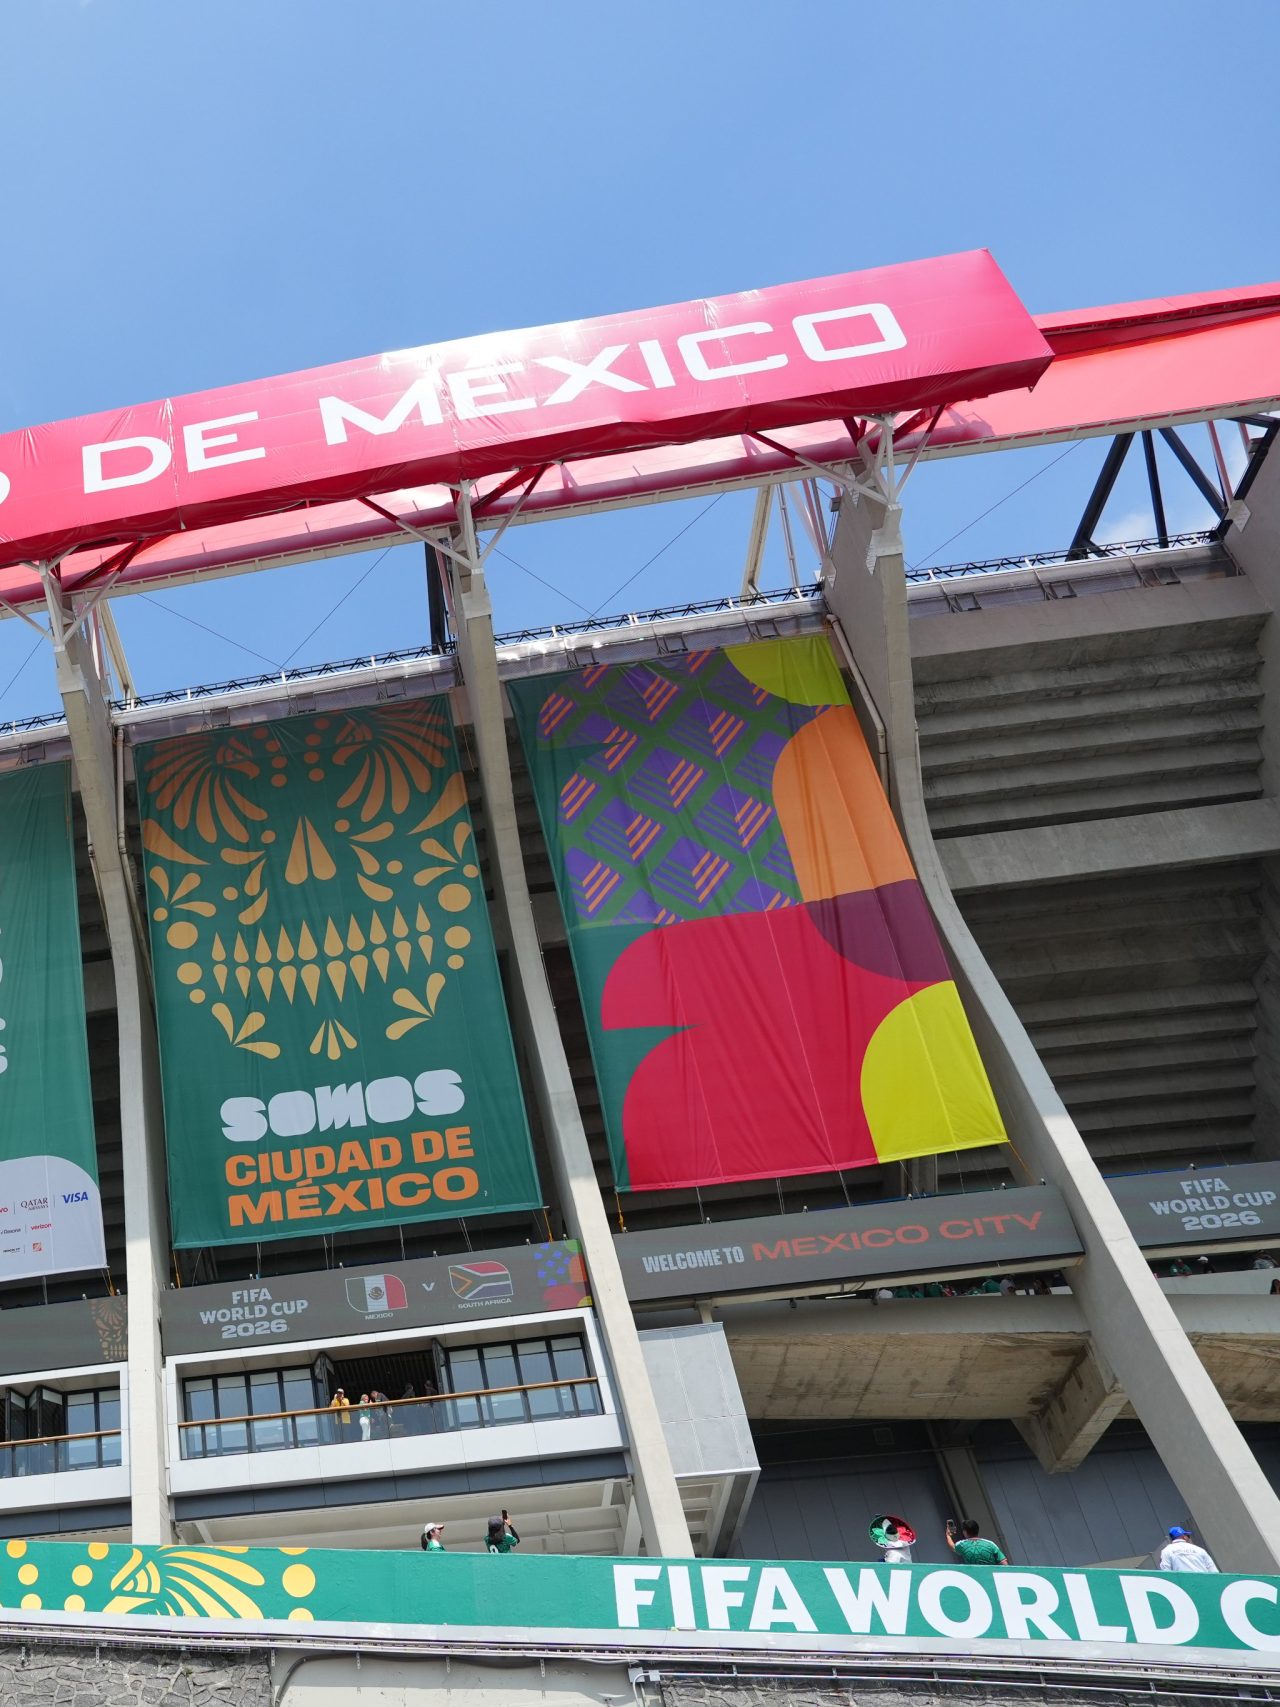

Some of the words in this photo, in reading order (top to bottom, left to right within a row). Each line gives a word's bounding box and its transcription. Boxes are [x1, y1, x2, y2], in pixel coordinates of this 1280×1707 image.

[82, 411, 266, 494] DE
[319, 302, 907, 445] MEXICO
[220, 1069, 465, 1142] SOMOS
[225, 1136, 403, 1187] CIUDAD
[411, 1126, 475, 1164] DE
[62, 1191, 88, 1204] VISA
[227, 1166, 480, 1227] MÉXICO
[1180, 1178, 1231, 1195] FIFA
[21, 1197, 48, 1208] QATAR
[1149, 1196, 1230, 1215] WORLD
[1232, 1191, 1277, 1207] CUP
[1181, 1210, 1261, 1231] 2026
[642, 1247, 720, 1273] WELCOME
[721, 1246, 744, 1264] TO
[751, 1225, 929, 1261] MEXICO
[938, 1211, 1042, 1240] CITY
[232, 1288, 272, 1305] FIFA
[458, 1302, 483, 1310] SOUTH
[484, 1298, 512, 1306] AFRICA
[200, 1304, 269, 1325] WORLD
[271, 1300, 308, 1316] CUP
[365, 1312, 393, 1320] MEXICO
[221, 1319, 288, 1339] 2026
[612, 1563, 819, 1633] FIFA
[821, 1568, 1200, 1646] WORLD
